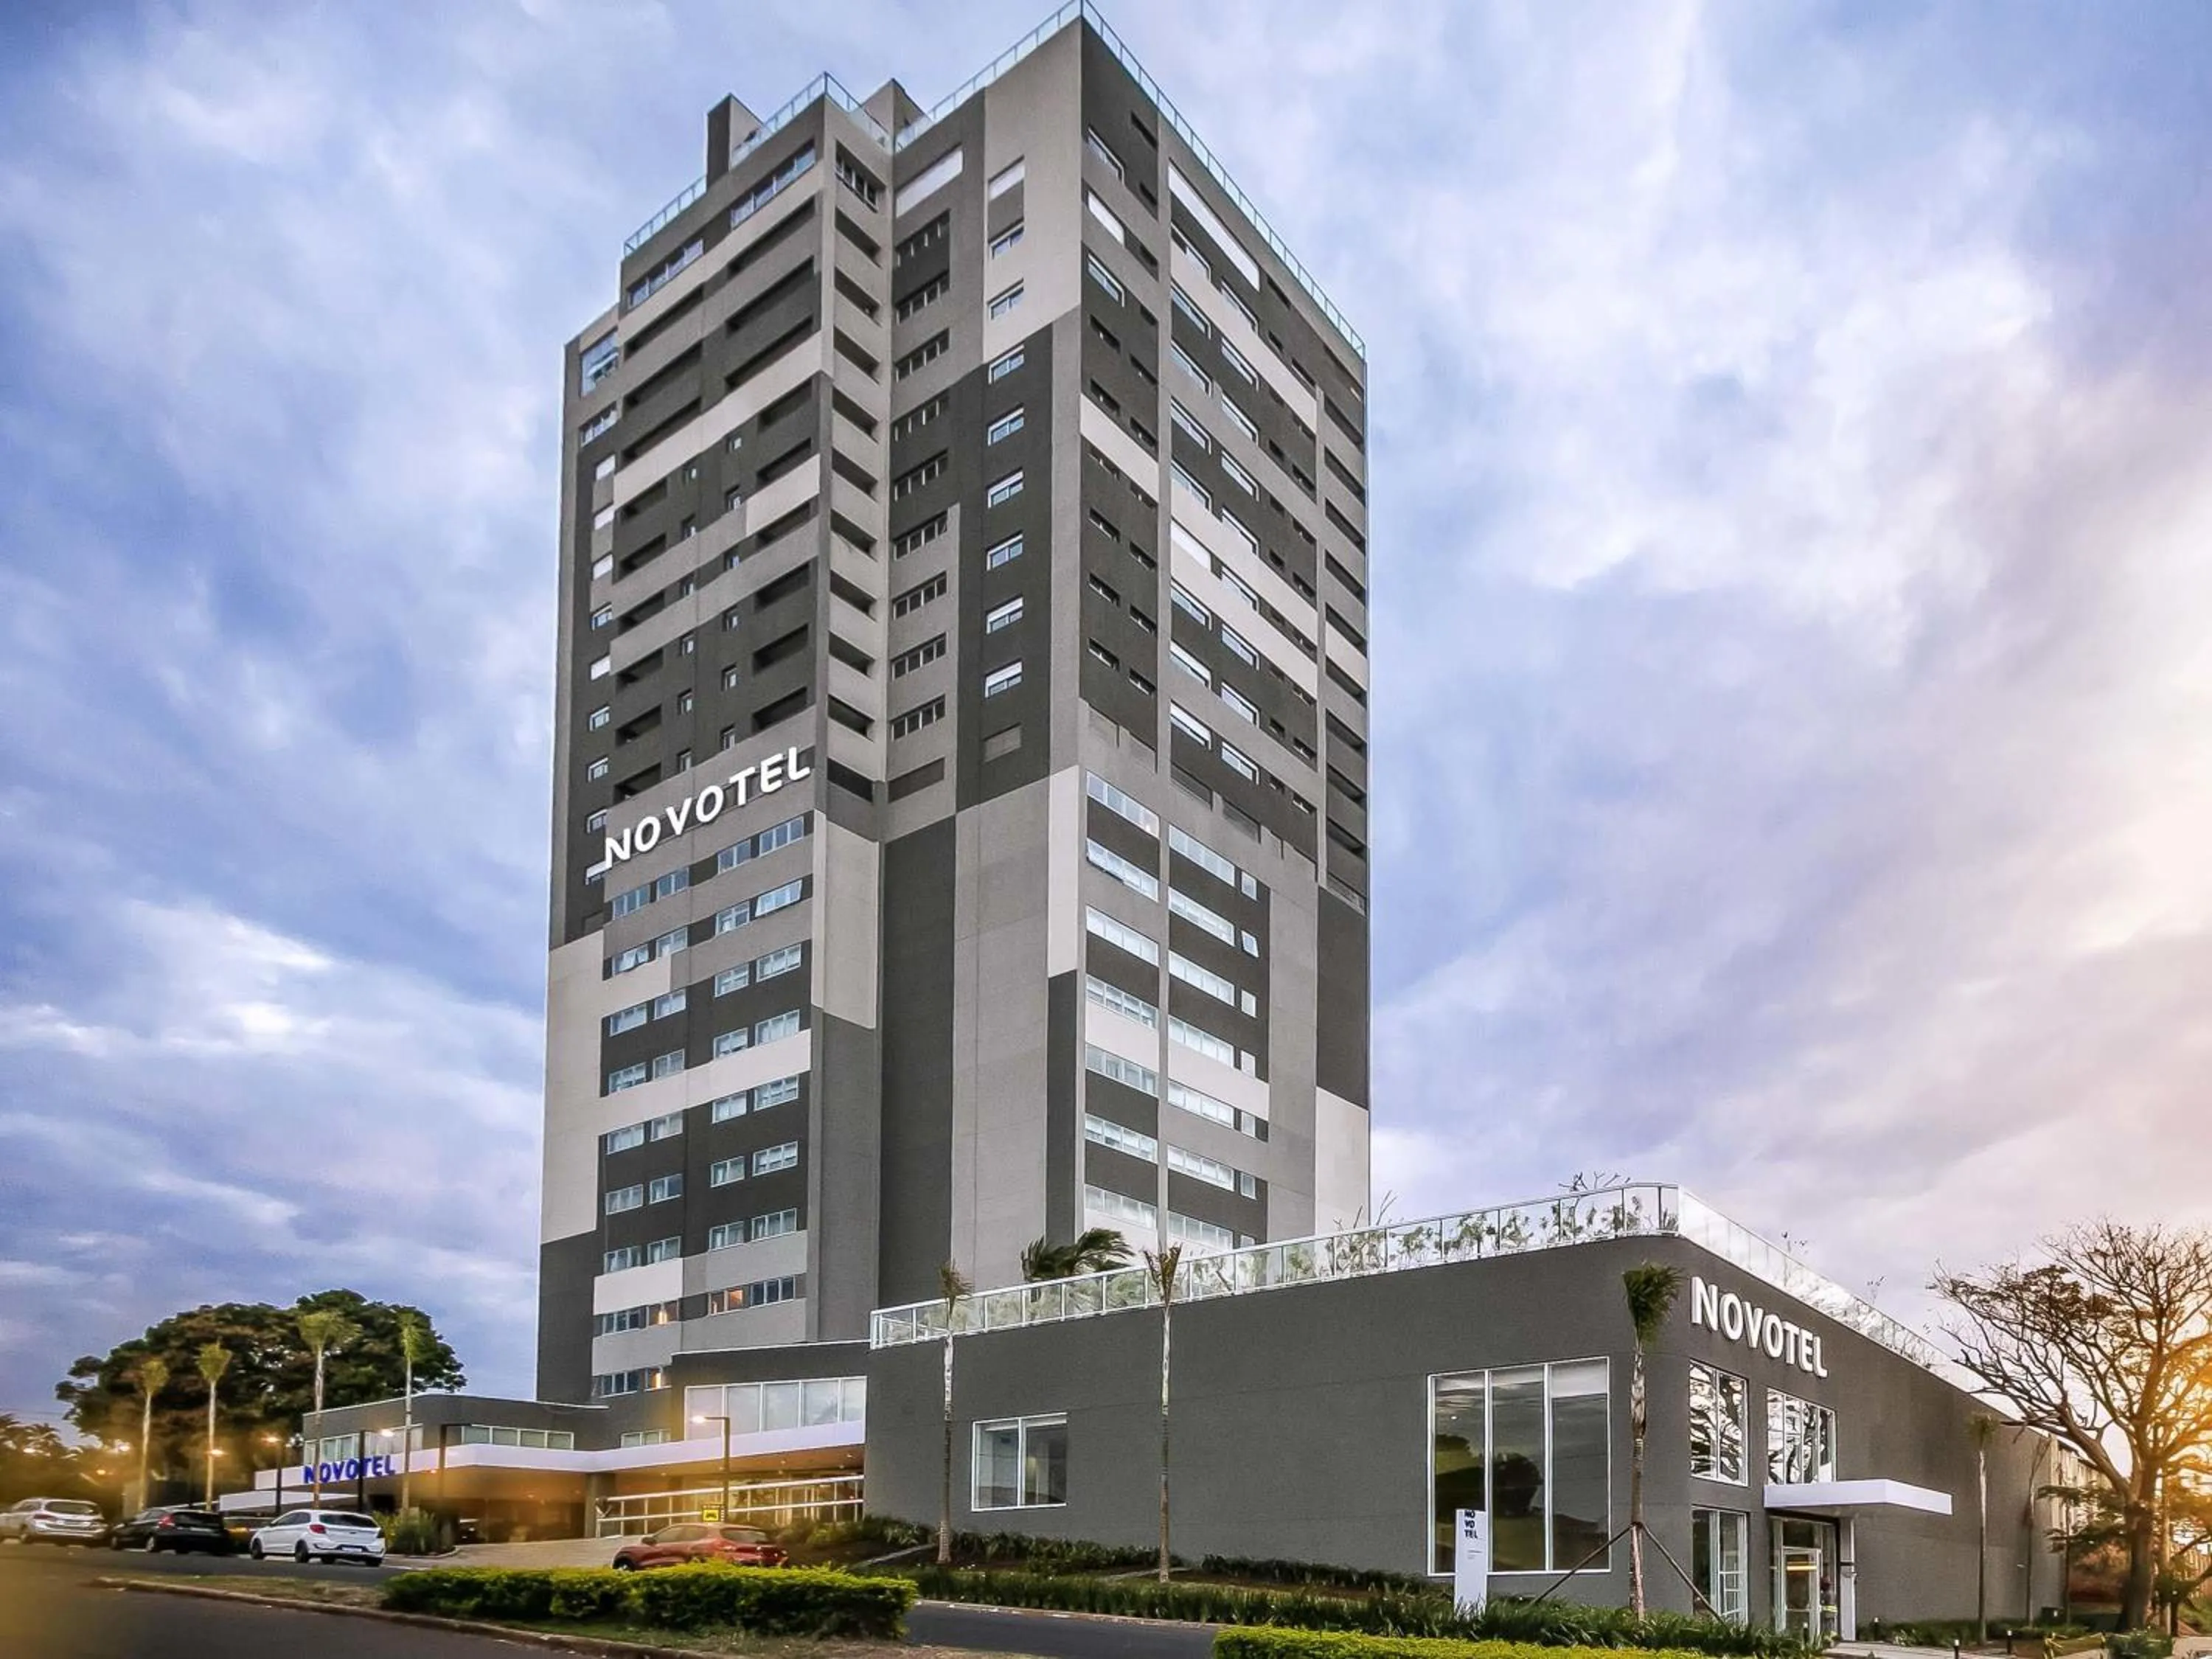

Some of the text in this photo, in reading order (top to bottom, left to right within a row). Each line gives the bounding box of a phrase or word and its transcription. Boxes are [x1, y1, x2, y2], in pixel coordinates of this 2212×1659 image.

[604, 746, 810, 869] NOVOTEL
[1691, 1276, 1828, 1378] NOVOTEL
[303, 1455, 395, 1484] NOVOTEL
[1464, 1510, 1475, 1518] NO
[1464, 1520, 1475, 1528] VO
[1464, 1528, 1478, 1539] TEL
